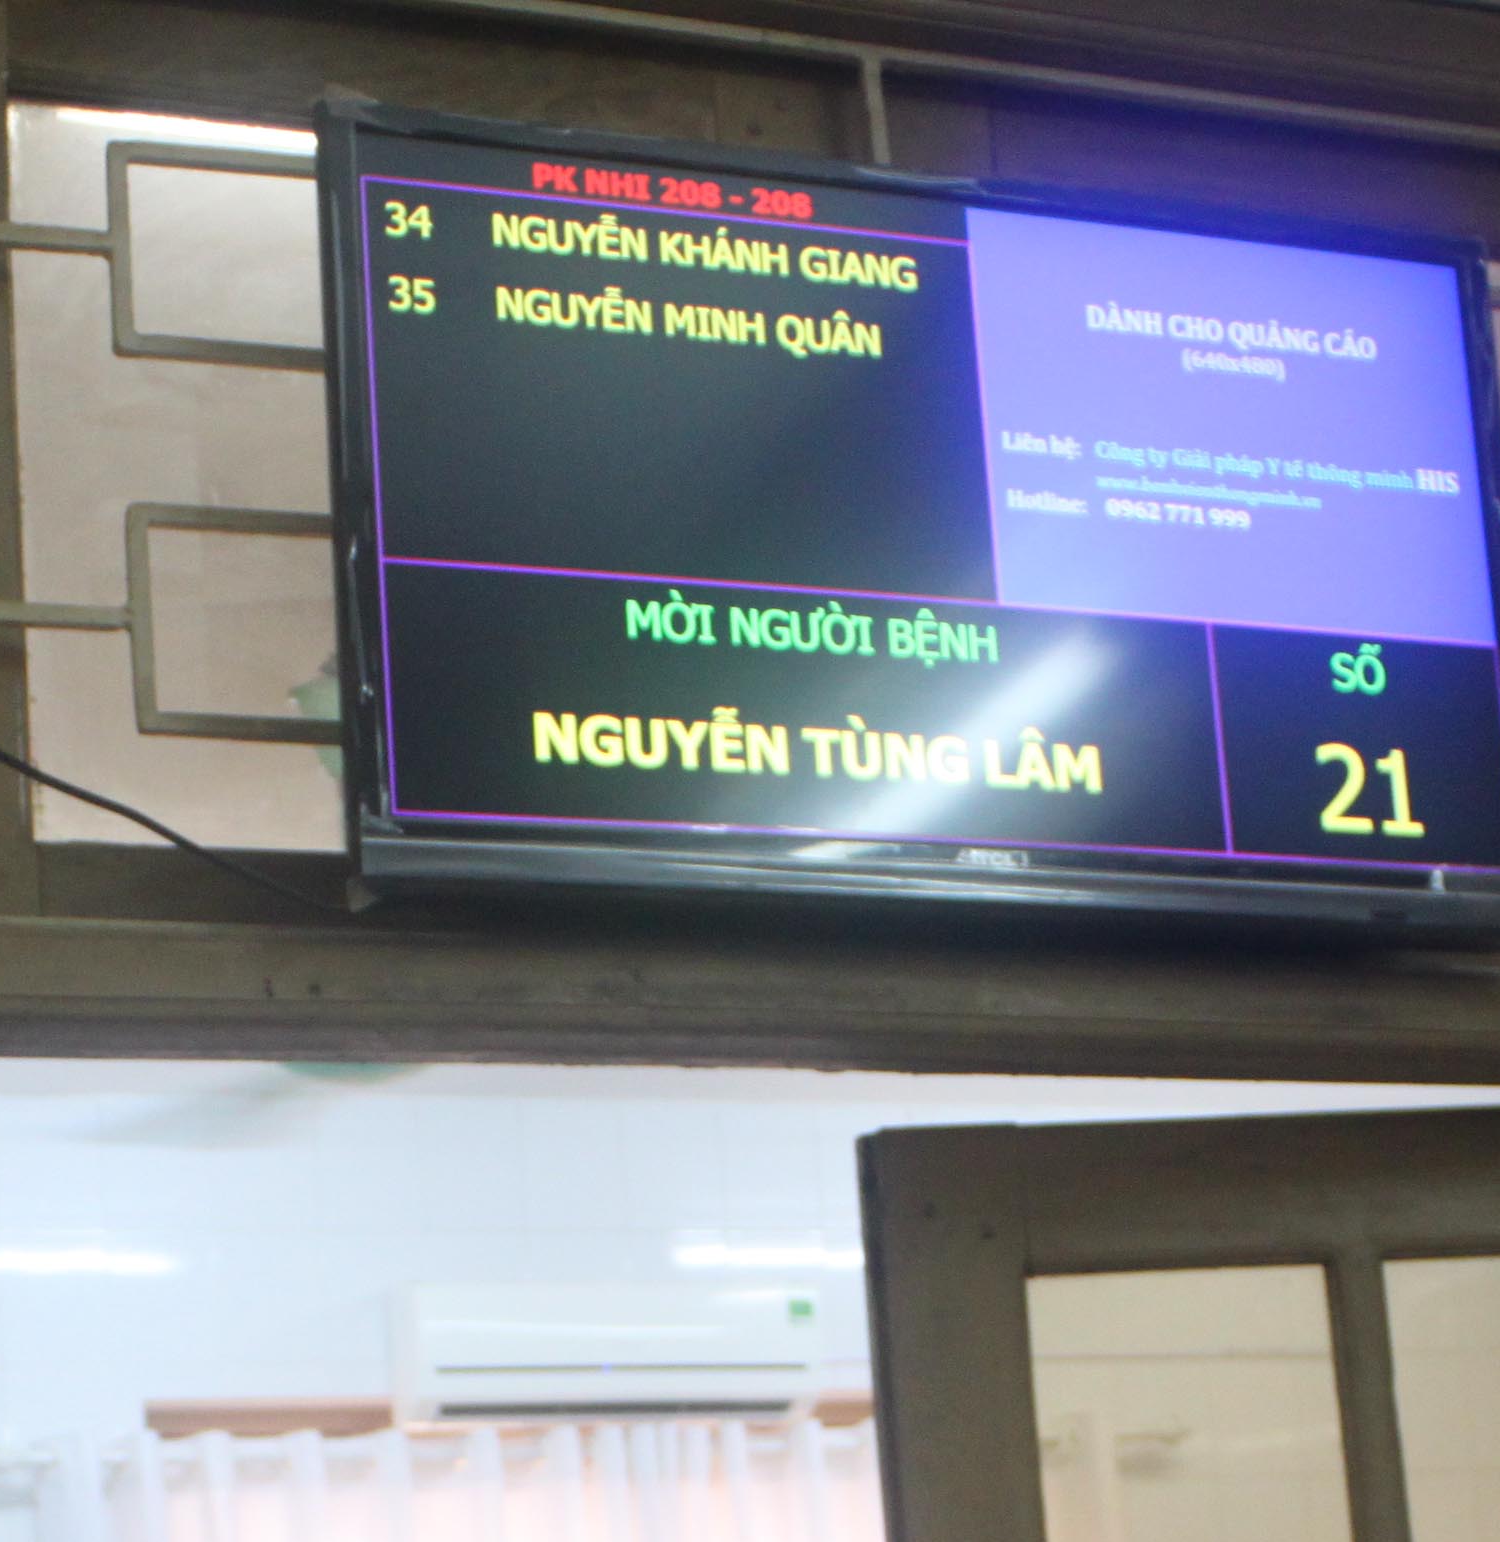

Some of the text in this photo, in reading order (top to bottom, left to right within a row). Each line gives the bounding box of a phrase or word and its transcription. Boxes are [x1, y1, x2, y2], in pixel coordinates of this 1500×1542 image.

[532, 162, 579, 193] PK
[584, 167, 652, 201] NHI
[659, 177, 722, 209] 208
[751, 187, 814, 220] 208
[384, 201, 919, 293] 34 NGUYỄN KHÁNH GIANG
[387, 275, 883, 359] 35 NGUYỄN MINH QUÂN
[1085, 301, 1378, 361] DÀNH CHO QUẢNG CÁO
[1148, 447, 1168, 469] ty
[1265, 458, 1280, 475] Y
[1416, 468, 1460, 496] HIS
[1104, 497, 1161, 523] 0962
[1164, 502, 1206, 528] 771
[1208, 507, 1252, 531] 999
[625, 589, 1000, 669] MỜI NGƯỜI BỆNH
[1329, 642, 1387, 697] SỐ
[532, 706, 1104, 794] NGUYỄN TÙNG LÂM
[1314, 741, 1426, 839] 21
